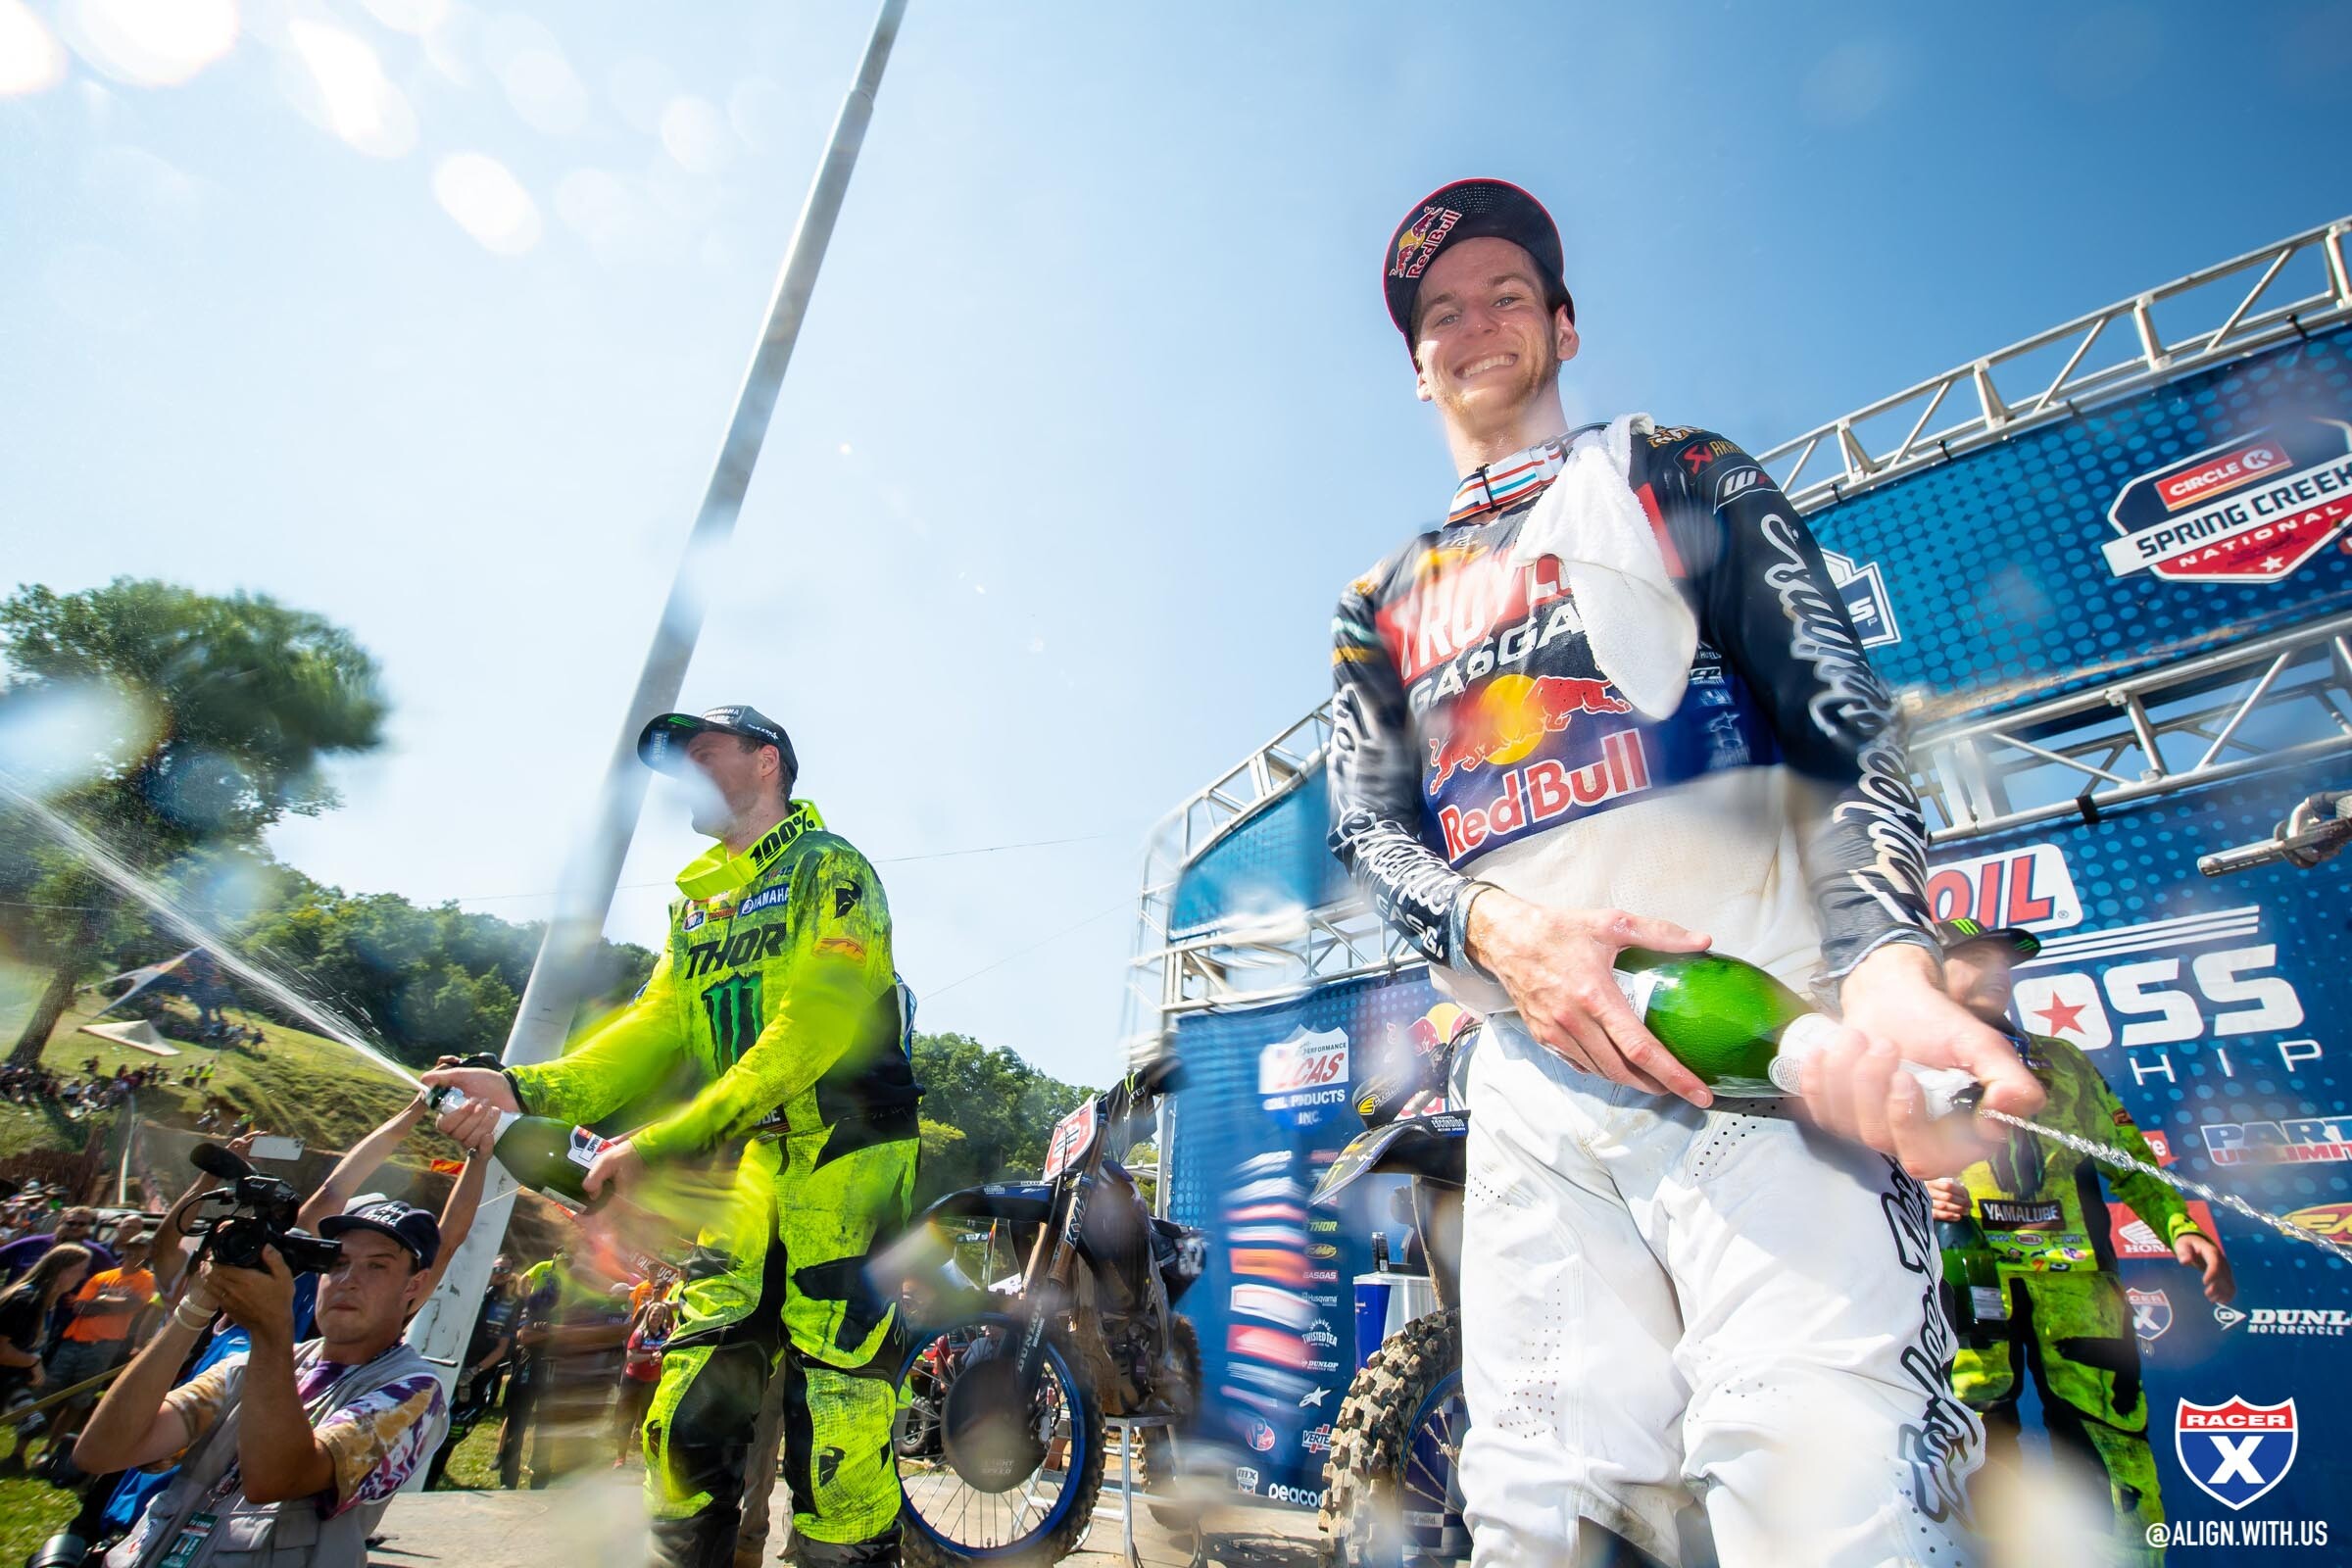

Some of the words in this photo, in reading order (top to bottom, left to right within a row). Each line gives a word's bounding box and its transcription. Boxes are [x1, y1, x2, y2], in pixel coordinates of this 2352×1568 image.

[1406, 242, 1435, 278] Red
[1426, 209, 1463, 246] Bull
[2169, 462, 2241, 497] CIRCLE
[2244, 449, 2274, 469] K
[2136, 502, 2249, 559] SPRING
[2179, 506, 2344, 568] NATIONAL
[1409, 602, 1586, 714] GASGA
[1438, 770, 1527, 865] Red
[1524, 727, 1653, 822] Bull
[749, 809, 816, 870] 100%
[685, 921, 787, 980] THOR
[2200, 1115, 2352, 1151] PART
[1309, 1220, 1338, 1232] THOR
[1983, 1202, 2060, 1223] YAMALUBE
[1302, 1271, 1338, 1280] GASGAS
[2247, 1324, 2345, 1337] MOTORCYCLE
[2248, 1308, 2352, 1327] DUNL
[1301, 1331, 1327, 1346] TWISTED
[1326, 1331, 1339, 1348] TEA
[1307, 1360, 1340, 1369] DUNLOP
[1302, 1431, 1330, 1445] VERTE
